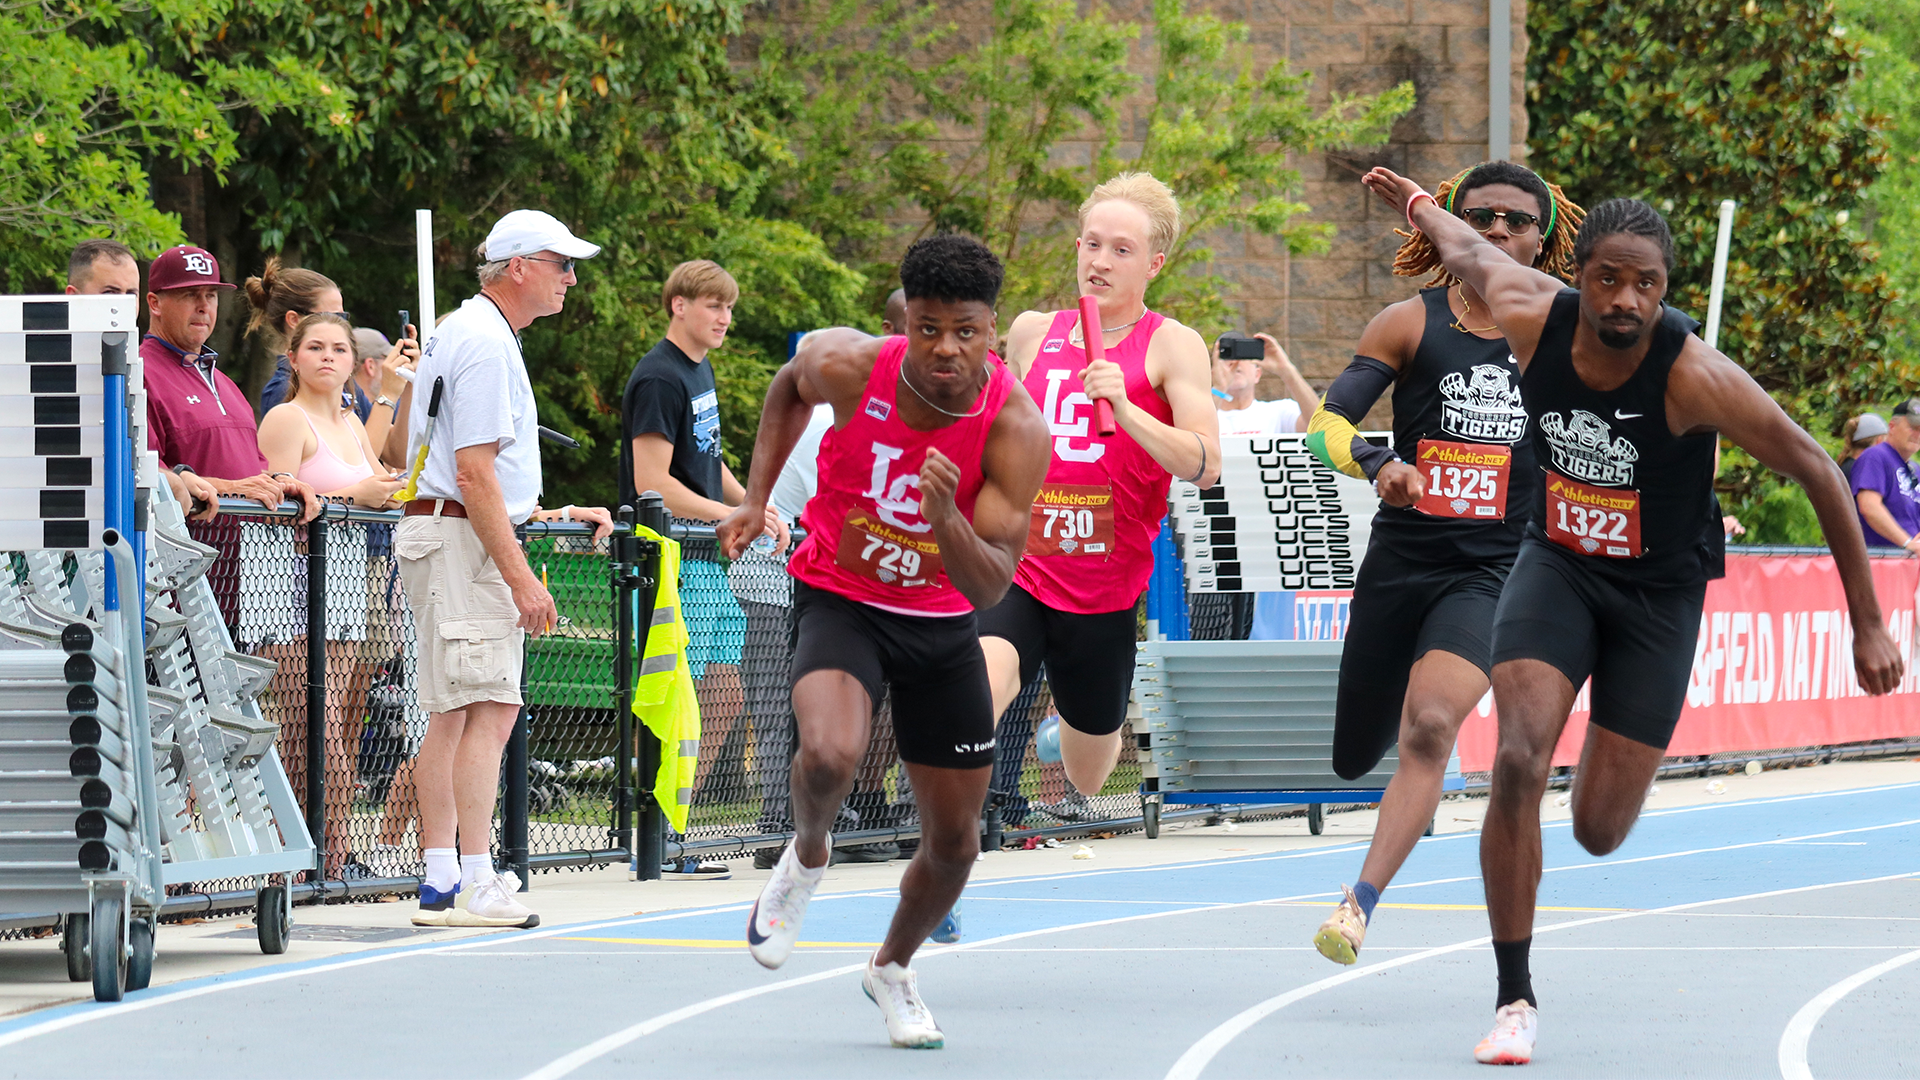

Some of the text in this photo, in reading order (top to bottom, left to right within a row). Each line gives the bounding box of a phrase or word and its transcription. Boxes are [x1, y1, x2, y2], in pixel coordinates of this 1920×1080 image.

[1445, 407, 1525, 440] TIGERS
[1250, 438, 1311, 454] UC
[1551, 444, 1630, 485] TIGERS
[1261, 470, 1335, 484] UCS
[1428, 465, 1498, 500] 1325
[1264, 485, 1339, 499] UCS
[1268, 500, 1342, 514] UCS
[1043, 508, 1094, 539] 730
[1276, 515, 1350, 530] UCS
[1557, 501, 1628, 542] 1322
[1275, 531, 1349, 544] UCS
[861, 534, 921, 577] 729
[1277, 545, 1351, 559] UCS
[1280, 560, 1354, 575] UCS
[1282, 575, 1355, 589] UCS
